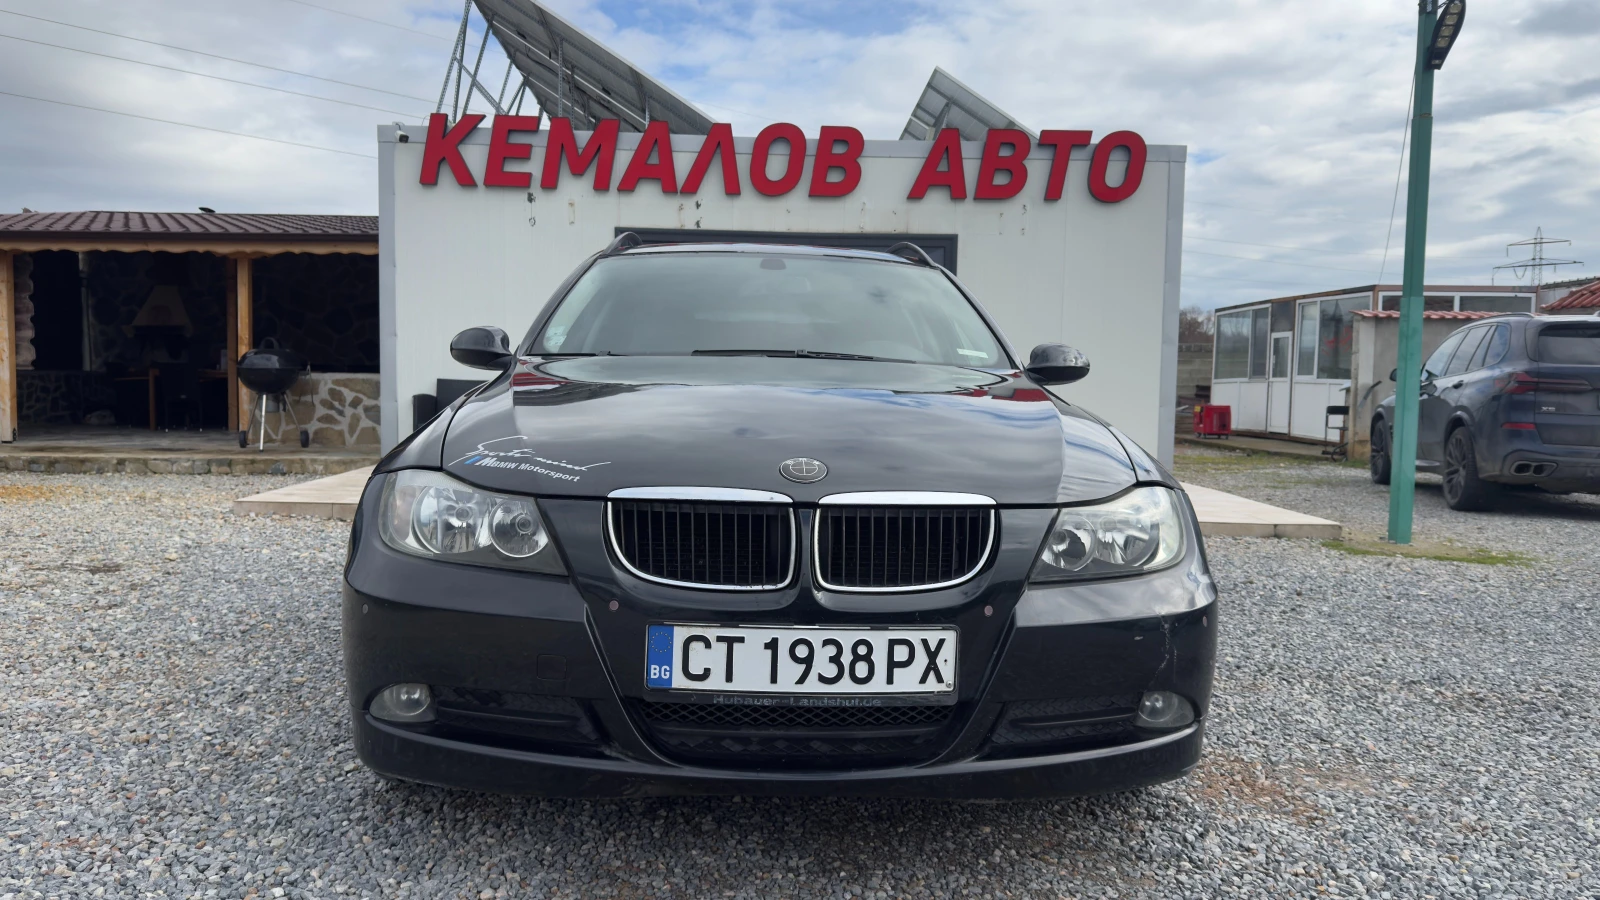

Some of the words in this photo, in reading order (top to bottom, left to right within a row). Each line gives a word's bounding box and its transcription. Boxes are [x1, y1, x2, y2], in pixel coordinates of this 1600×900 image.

[419, 113, 865, 198] КЕМАЛОВ
[906, 128, 1148, 203] АВТО
[518, 463, 580, 482] Motorsport
[650, 664, 670, 679] BG
[763, 636, 875, 685] 1938
[886, 637, 947, 685] PX
